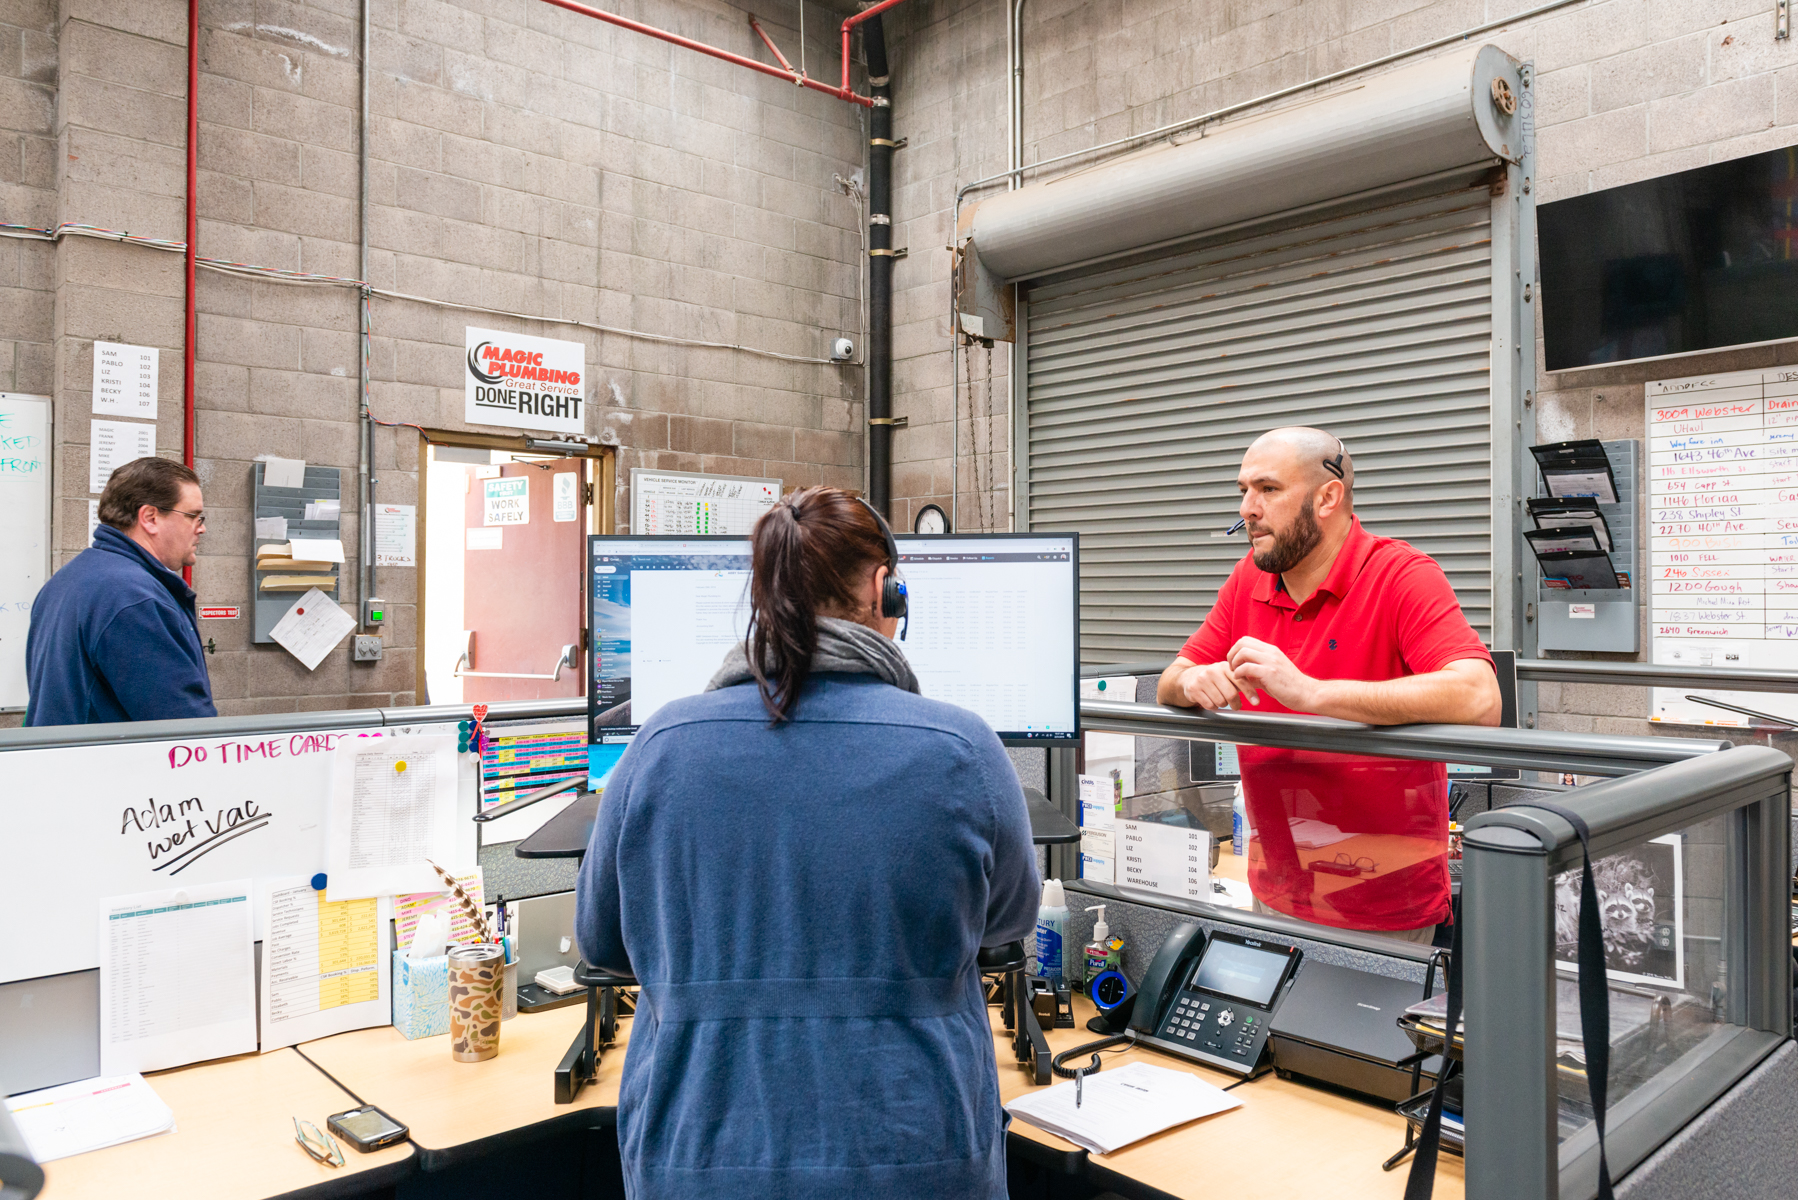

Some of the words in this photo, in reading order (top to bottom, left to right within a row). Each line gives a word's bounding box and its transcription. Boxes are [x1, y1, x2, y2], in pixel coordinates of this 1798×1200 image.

[482, 346, 543, 366] MAGIC
[488, 361, 580, 385] PLUMBING
[505, 379, 536, 390] Great
[540, 383, 578, 395] Service
[476, 386, 516, 405] DONE
[519, 391, 582, 419] RIGHT
[1656, 409, 1688, 421] 3009
[1695, 404, 1755, 418] Webster
[1674, 451, 1702, 462] 1643
[1734, 448, 1756, 458] Ave
[488, 481, 524, 492] SAFETY
[1668, 482, 1686, 490] 654
[491, 499, 520, 509] WORK
[488, 511, 523, 522] SAFELY
[1659, 511, 1683, 520] 238
[1660, 524, 1691, 534] 2270
[1669, 538, 1700, 550] 900
[1705, 536, 1742, 549] Bush
[1669, 583, 1702, 592] 1200
[1705, 581, 1742, 593] Gough
[1699, 612, 1731, 620] Webster
[1687, 627, 1728, 635] Greenwich
[168, 745, 208, 769] DO
[214, 738, 283, 764] TIME
[289, 734, 349, 756] CARD
[121, 797, 203, 834] Adam
[148, 824, 198, 859] wet
[205, 799, 259, 834] vac
[1127, 877, 1158, 888] WAREHOUSE
